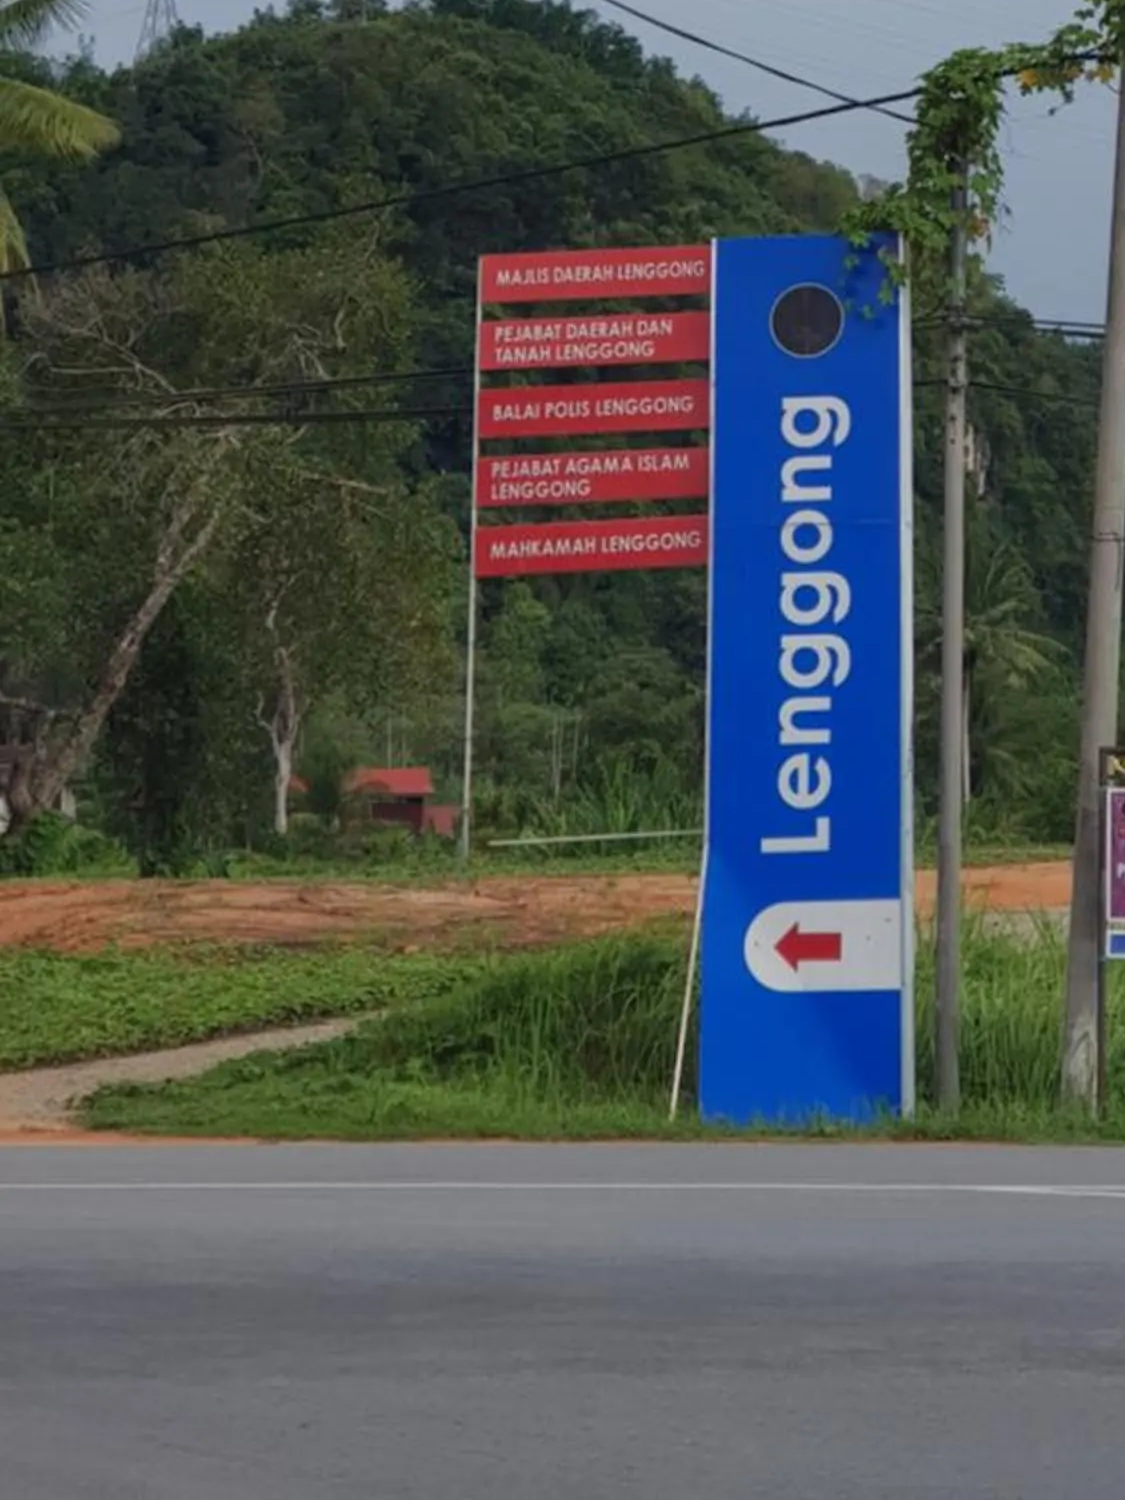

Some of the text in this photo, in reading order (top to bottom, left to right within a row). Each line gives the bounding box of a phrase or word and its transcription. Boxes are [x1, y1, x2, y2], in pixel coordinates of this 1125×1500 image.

[496, 260, 705, 286] MAJLIS DAERAH LENGGONG
[494, 319, 673, 342] PEJABAT DAERAH DAN
[495, 341, 655, 363] TANAH LENGGONG
[493, 396, 695, 421] BALAI POLIS LENGGONG
[491, 454, 690, 478] PEJABAT AGAMA ISLAM
[491, 480, 591, 500] LENGGONG
[490, 531, 701, 559] MAHKAMAH LENGGONG
[761, 395, 851, 855] Lenggong
